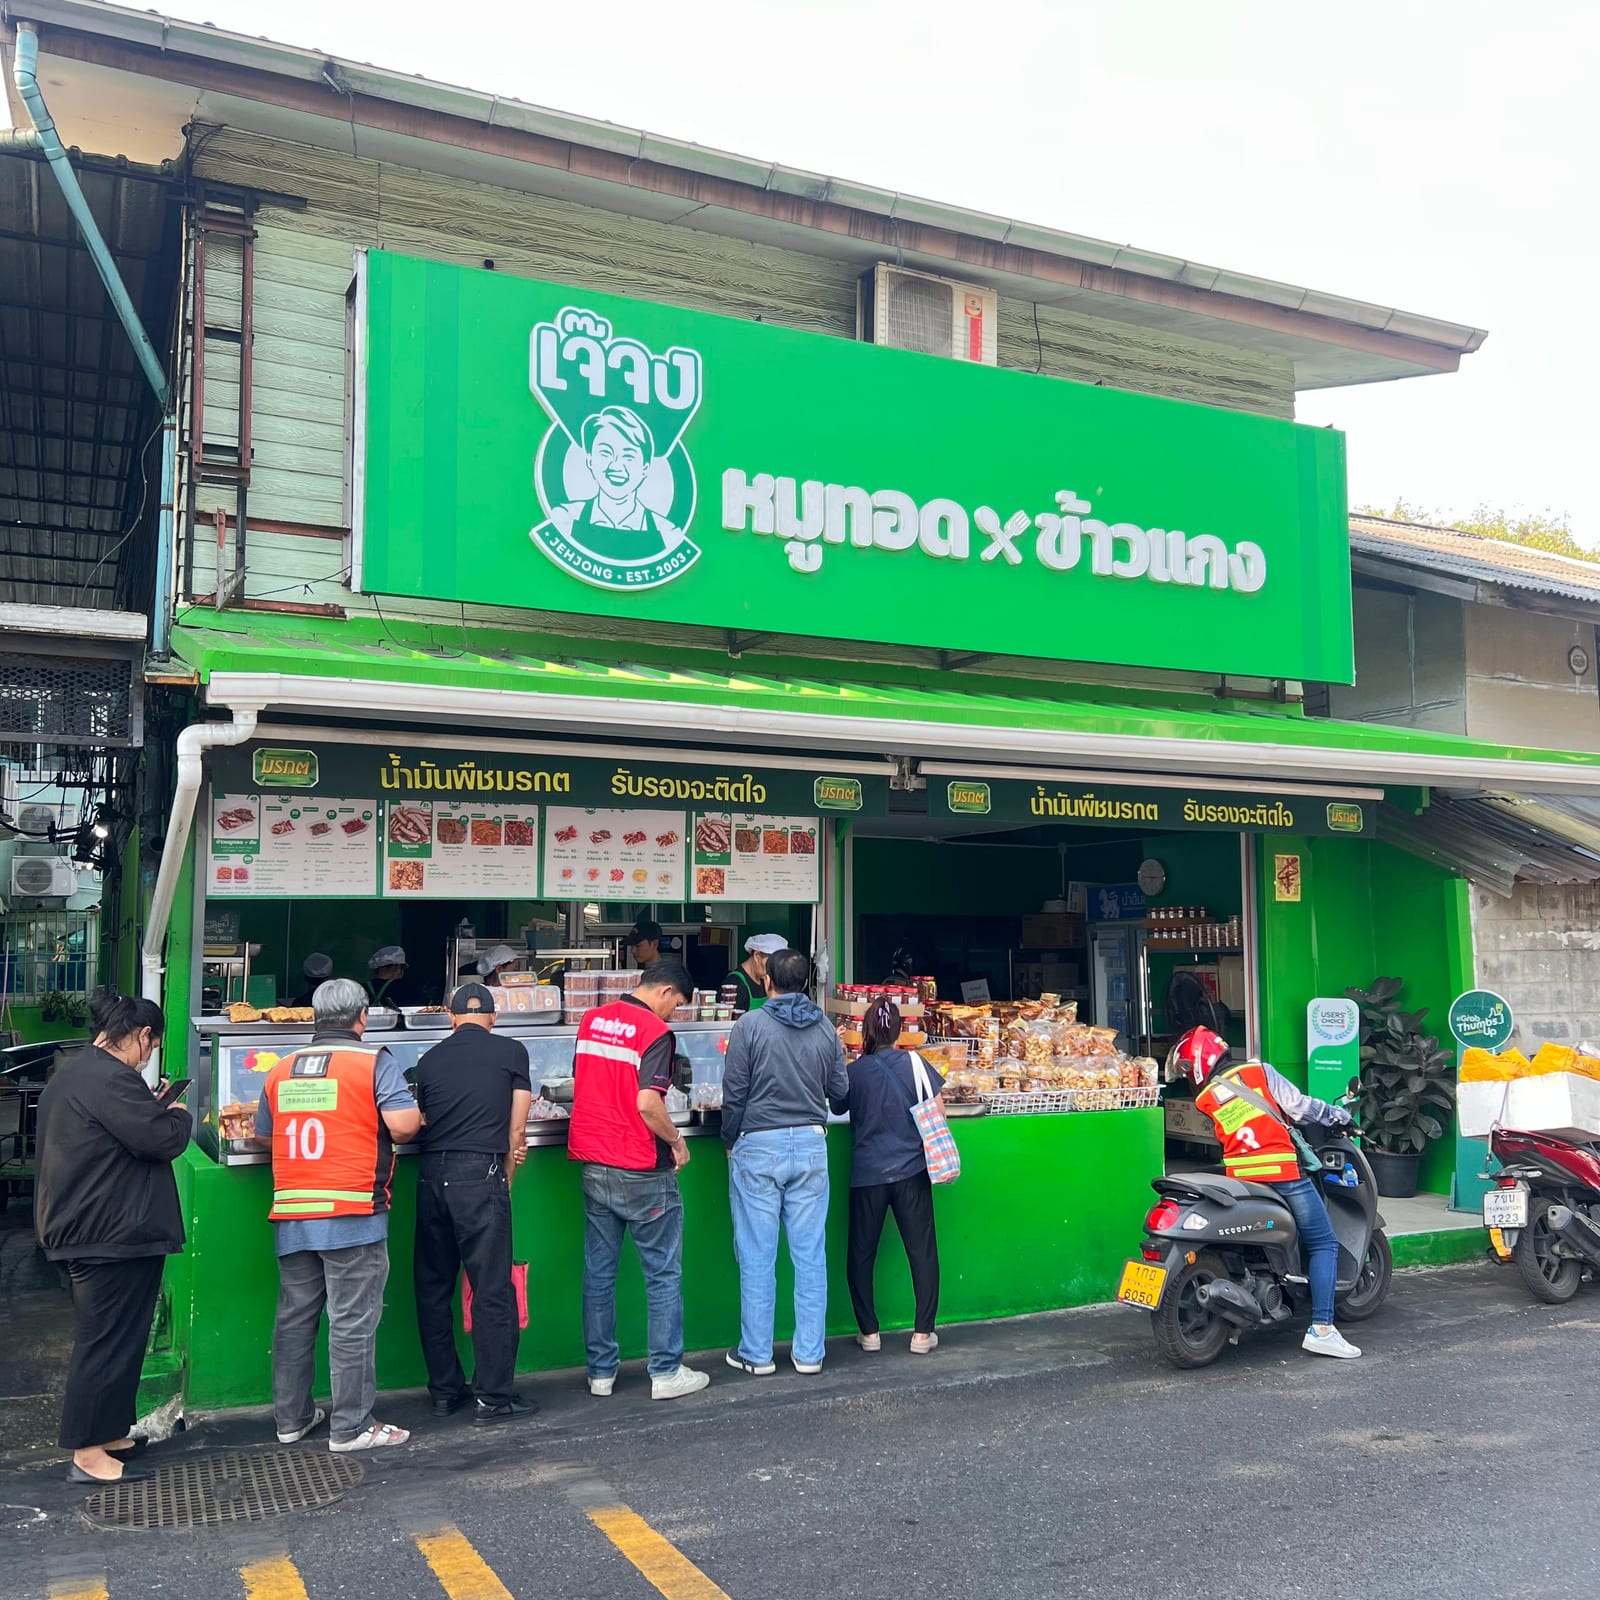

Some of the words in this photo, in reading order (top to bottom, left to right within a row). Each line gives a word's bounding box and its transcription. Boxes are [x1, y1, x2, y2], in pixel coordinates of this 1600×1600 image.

[722, 467, 970, 573] หมูทอด
[1035, 490, 1267, 593] ข้าวแกง
[549, 537, 613, 579] JEHJONG
[626, 570, 655, 582] EST.
[656, 553, 687, 577] 2003
[261, 757, 310, 775] มรกต
[380, 753, 571, 792] น้ำมันพืชมรกต
[611, 768, 767, 804] รับรองจะติดใจ
[1030, 786, 1159, 821] น้ำมันพืชมรกต
[1183, 798, 1294, 828] รับรองจะติดใจ
[590, 1016, 637, 1039] makro
[1456, 1017, 1498, 1033] Thumbs
[1483, 1026, 1498, 1038] Up
[285, 1117, 325, 1160] 10
[1491, 1212, 1519, 1223] 1223
[1124, 1288, 1153, 1304] 6050
